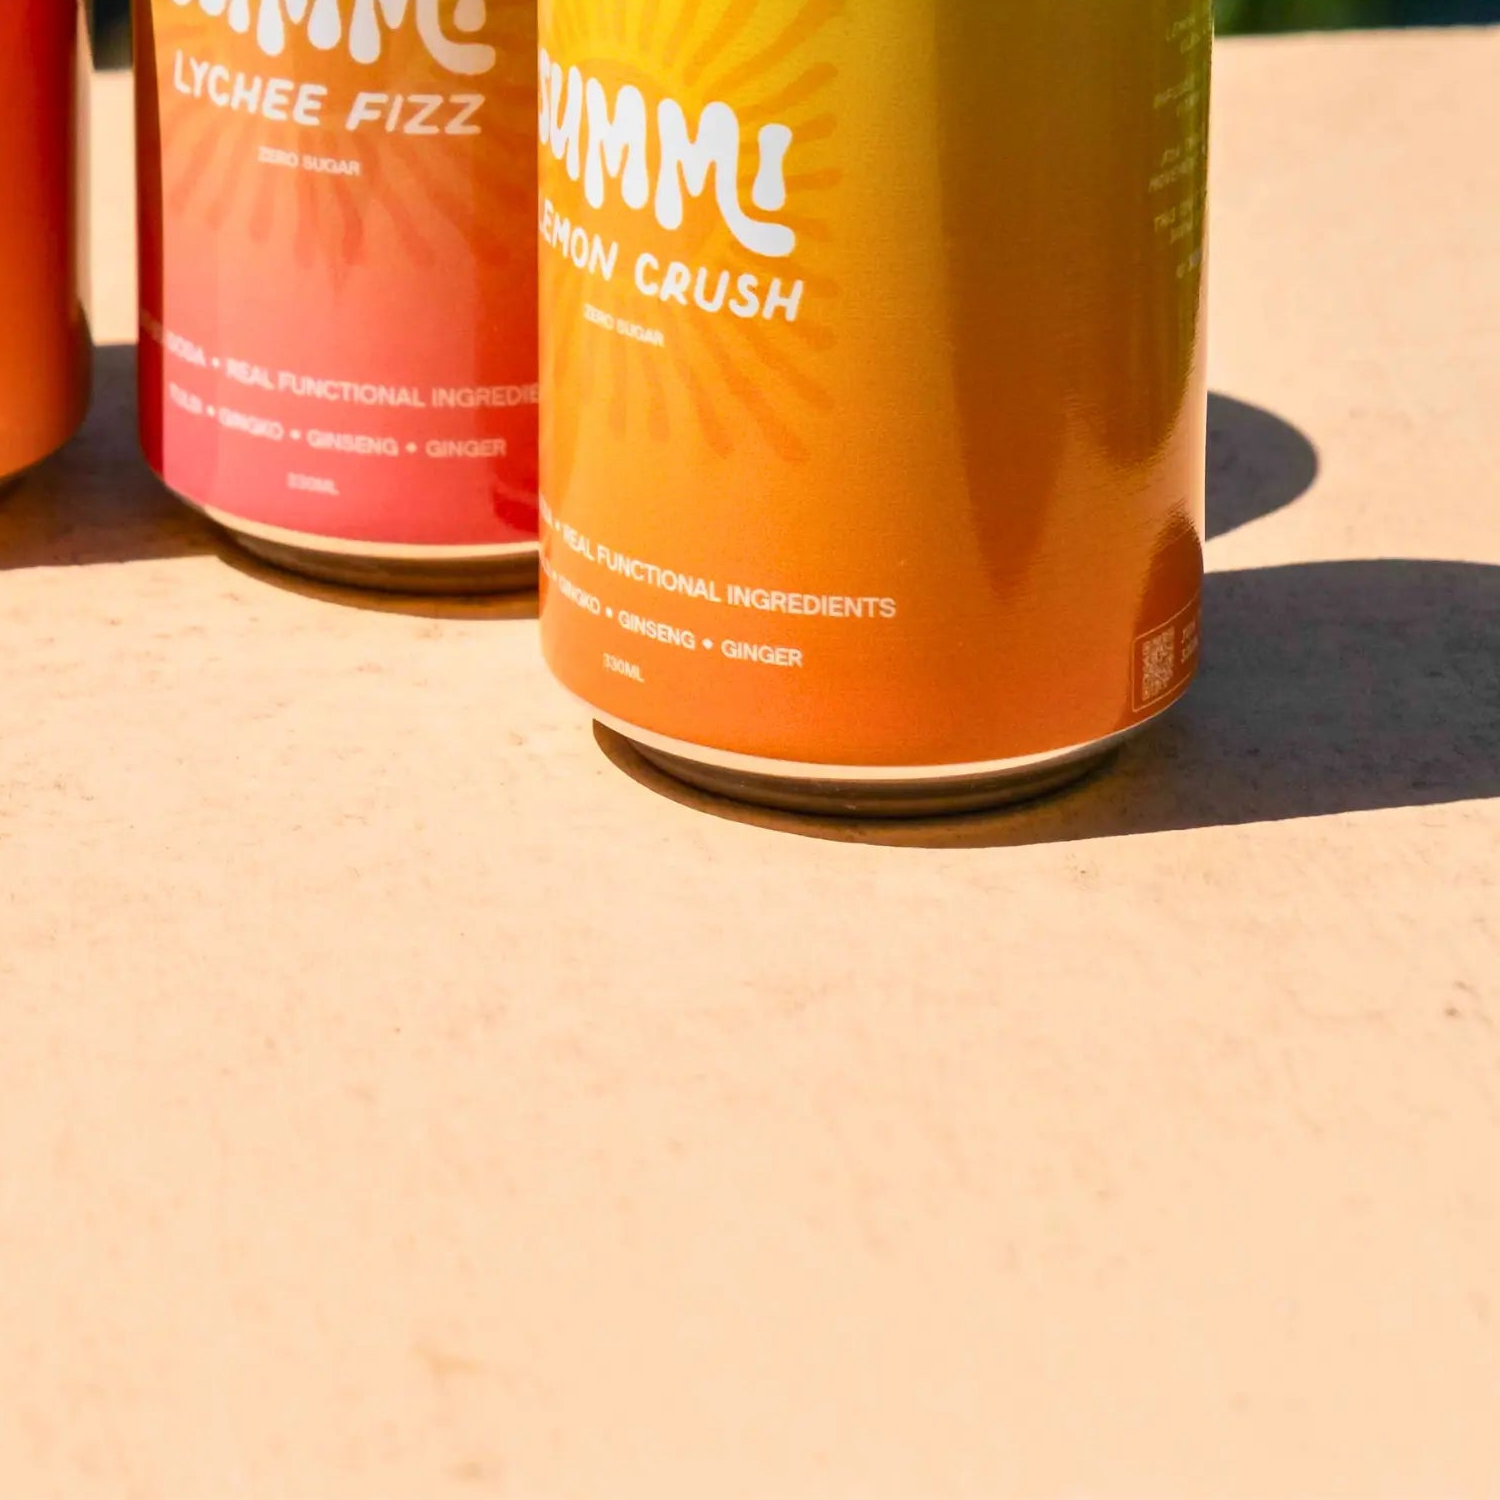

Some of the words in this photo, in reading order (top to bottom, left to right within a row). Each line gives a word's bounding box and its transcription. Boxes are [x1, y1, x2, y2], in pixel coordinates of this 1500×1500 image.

[173, 49, 328, 126] LYCHEE
[345, 91, 486, 136] FIZZ
[302, 151, 361, 178] SUGAR
[634, 252, 804, 322] CRUSH
[616, 318, 665, 348] SUGAR
[225, 357, 275, 390] REAL
[277, 370, 426, 408] FUNCTIONAL
[306, 429, 399, 457] GINSENG
[425, 438, 507, 458] GINGER
[562, 524, 595, 561] REAL
[597, 544, 721, 604] FUNCTIONAL
[727, 583, 897, 619] INGREDIENTS
[618, 610, 695, 650] GINSENG
[721, 639, 803, 668] GINGER
[603, 653, 645, 683] 330ML
